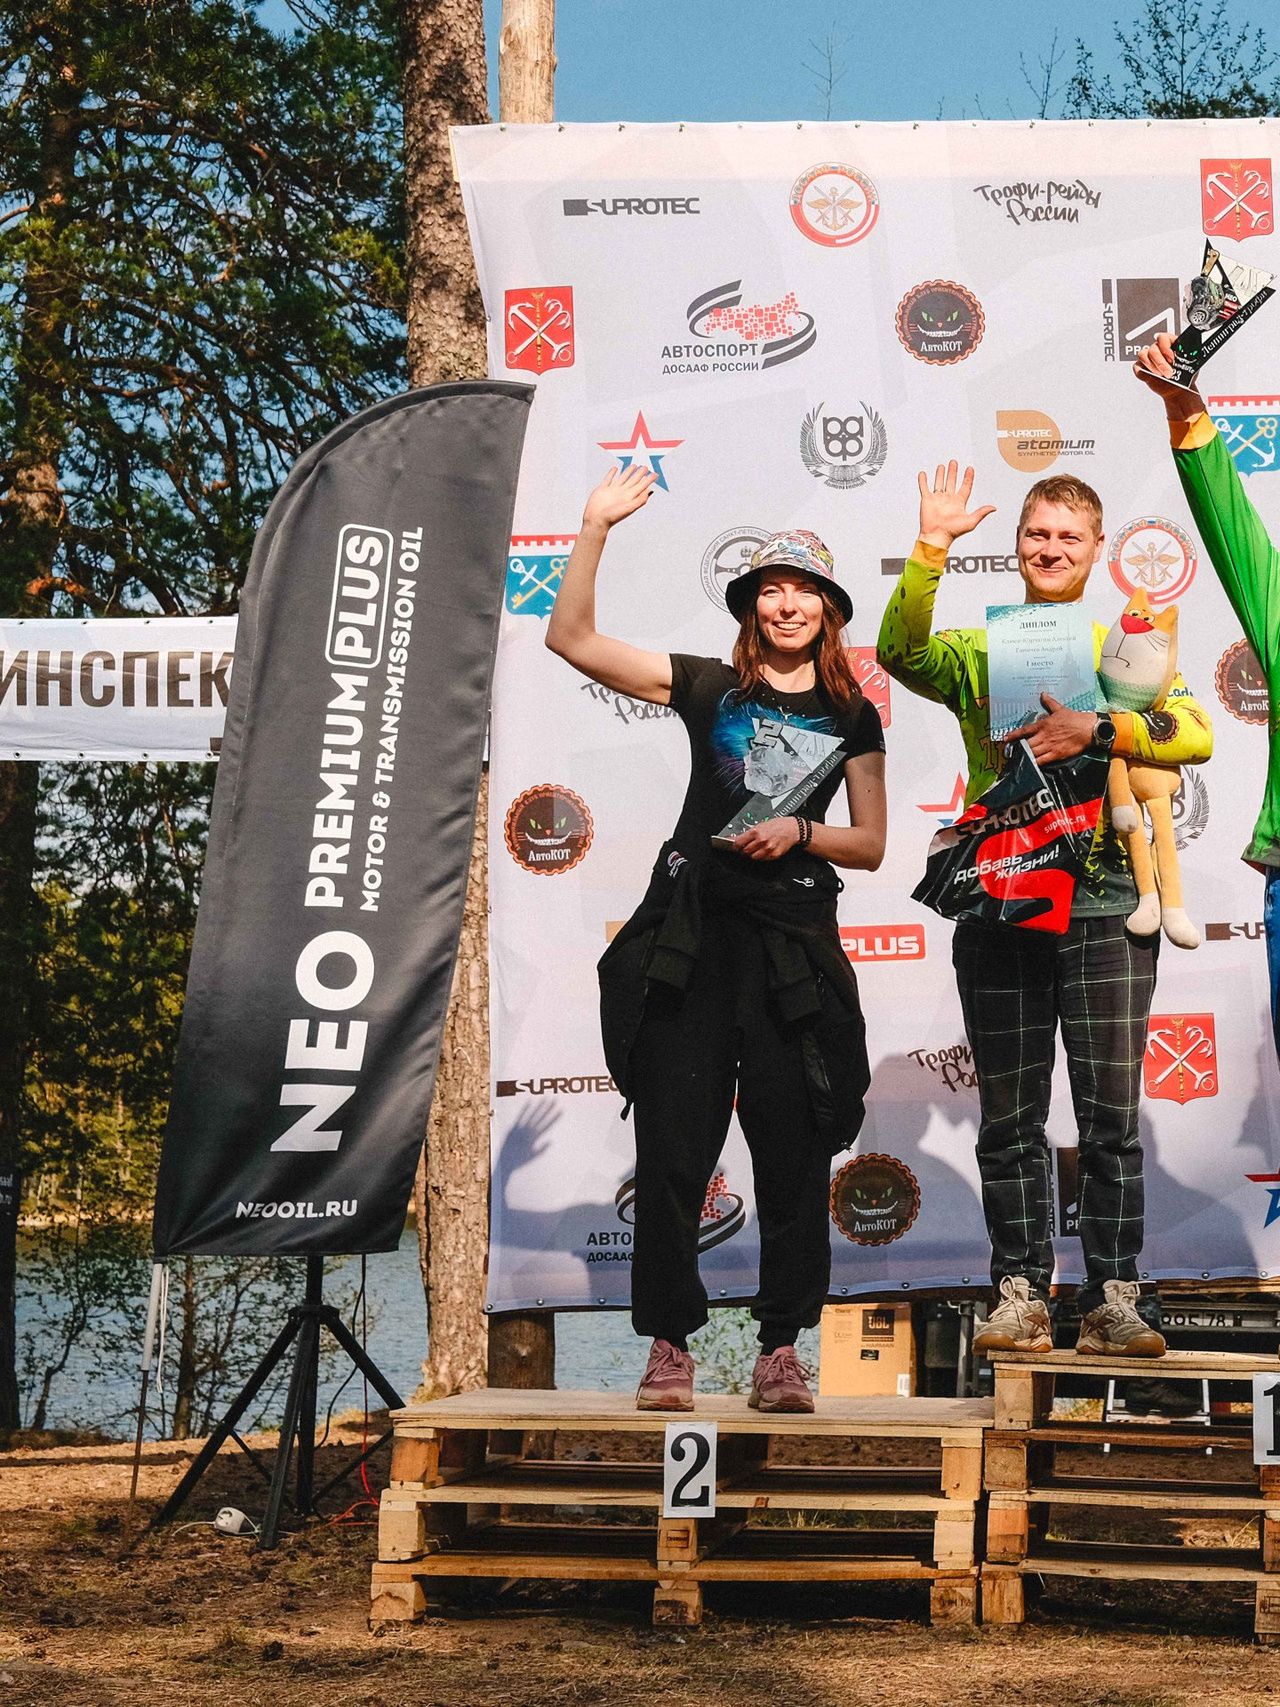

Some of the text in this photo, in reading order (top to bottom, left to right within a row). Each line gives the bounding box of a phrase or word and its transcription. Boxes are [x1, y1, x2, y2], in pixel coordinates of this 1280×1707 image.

[586, 197, 700, 216] SUPROTEC
[1006, 198, 1080, 226] России
[1104, 302, 1115, 361] SUPROTEC
[661, 343, 759, 359] АВТОСПОРТ
[662, 362, 759, 375] ДОСААФ РОССИИ
[1006, 429, 1052, 438] SUPROTEC
[1017, 439, 1095, 450] atomium
[1019, 620, 1057, 630] ДИПЛОМ
[1240, 700, 1269, 711] АвтоК
[360, 526, 424, 912] MOTOR & TRANSMISSION OIL
[753, 718, 783, 748] 2
[270, 534, 384, 1154] NEO PREMIUM PLUS
[954, 853, 1023, 885] добавь
[995, 844, 1060, 881] жизни!
[842, 935, 920, 957] PLUS
[236, 1199, 358, 1220] NEOOIL.RU
[868, 1316, 890, 1329] JBL
[670, 1431, 710, 1508] 2
